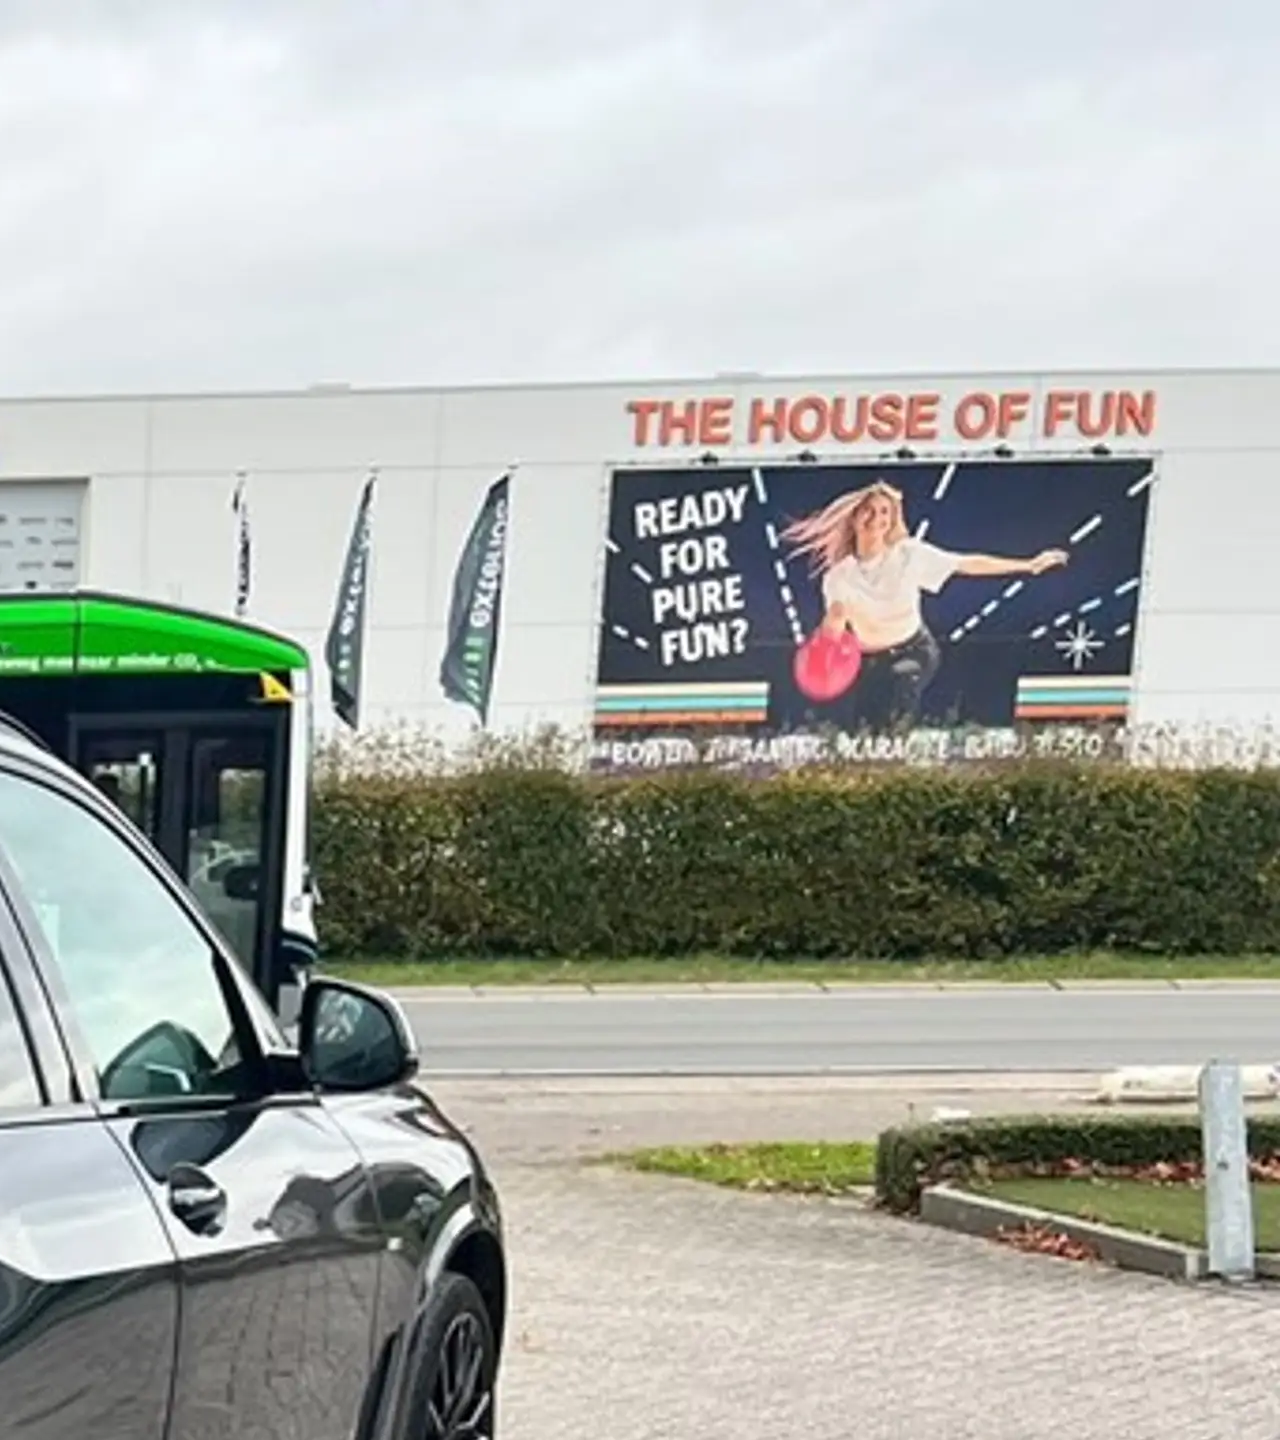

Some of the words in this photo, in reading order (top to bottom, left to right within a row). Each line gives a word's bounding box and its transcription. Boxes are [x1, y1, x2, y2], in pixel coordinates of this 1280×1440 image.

[627, 400, 733, 447] THE
[747, 395, 939, 444] HOUSE
[953, 393, 1030, 440] OF
[1043, 390, 1156, 438] FUN
[634, 485, 748, 538] READY
[660, 535, 730, 579] FOR
[652, 574, 745, 624] PURE
[661, 618, 749, 666] FUN?
